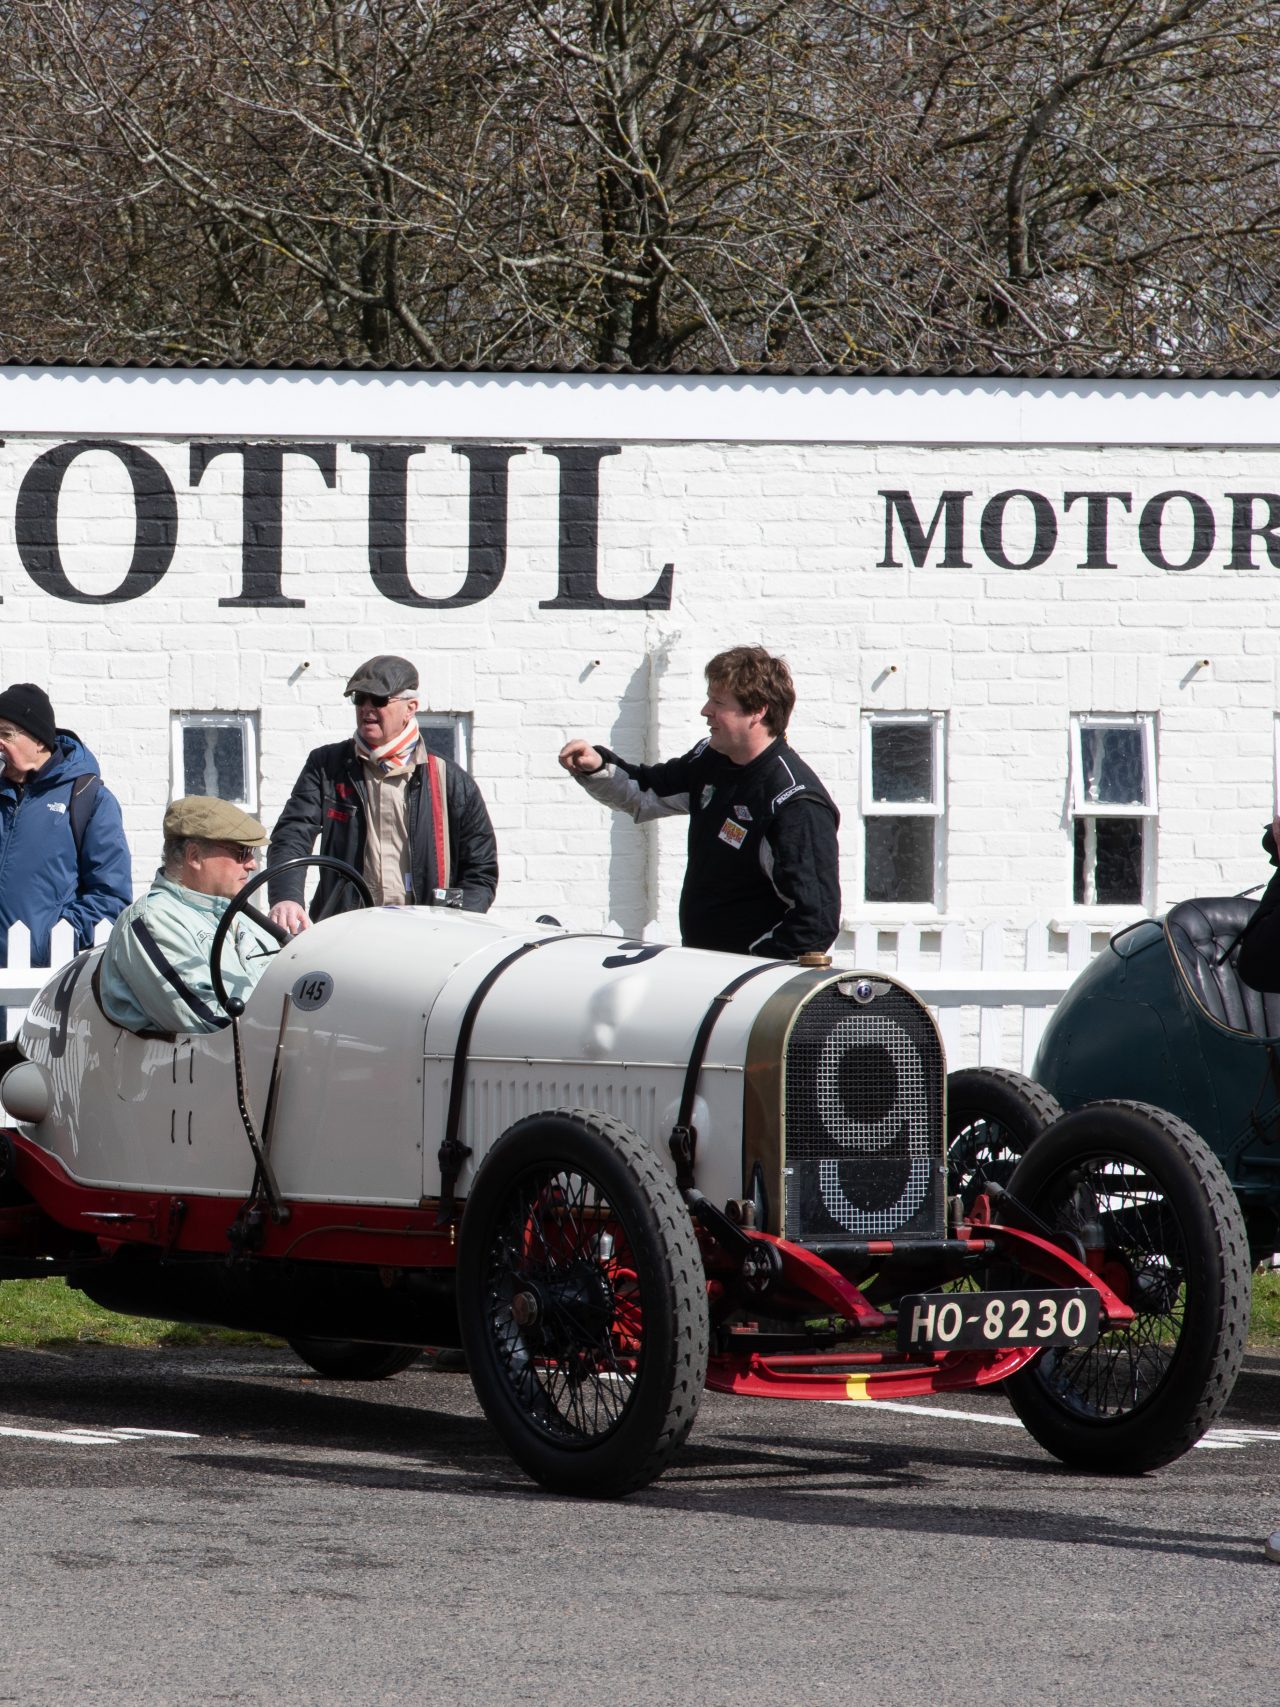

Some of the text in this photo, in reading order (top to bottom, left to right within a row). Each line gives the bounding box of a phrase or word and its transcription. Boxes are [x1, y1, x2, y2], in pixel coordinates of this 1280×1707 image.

[49, 951, 91, 1058] 9
[299, 980, 326, 1001] 145
[817, 1016, 930, 1234] 9
[910, 1298, 1087, 1343] HO-8230
